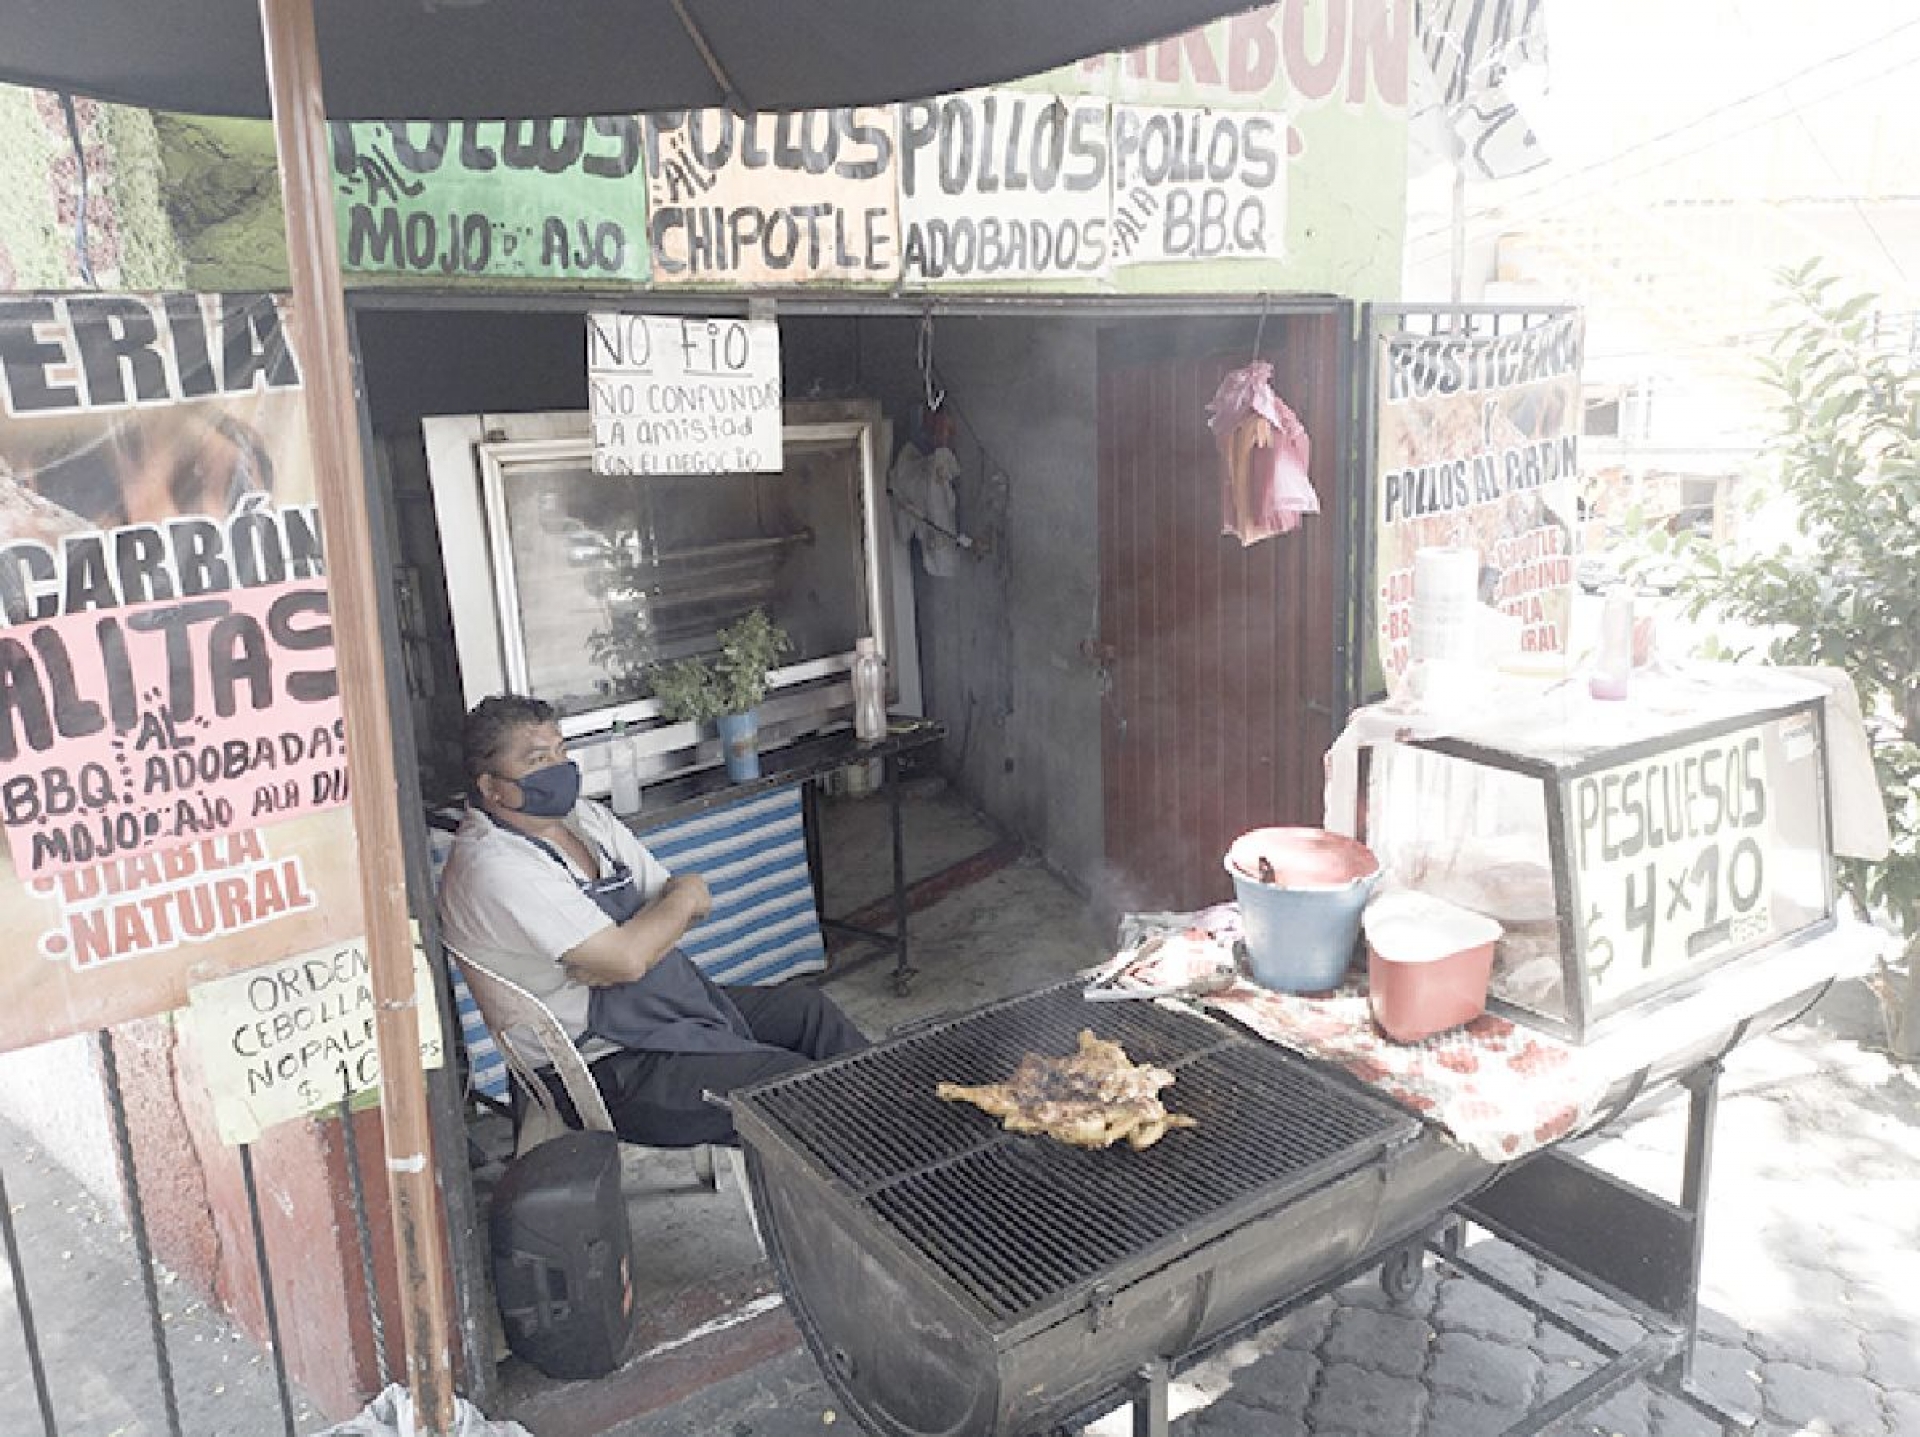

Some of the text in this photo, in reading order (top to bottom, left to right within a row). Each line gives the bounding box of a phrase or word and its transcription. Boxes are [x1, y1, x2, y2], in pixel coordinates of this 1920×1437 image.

[902, 95, 1107, 197] POLLOS
[1115, 109, 1278, 190] POLLOS
[347, 203, 491, 274] MOJO
[541, 214, 625, 271] AJO
[652, 202, 890, 275] CHIPOTLE
[904, 216, 1107, 278] ADOBADOS
[0, 293, 302, 414] ERIA
[589, 313, 651, 366] NO
[591, 383, 635, 415] NO
[0, 589, 340, 762] ALITAS
[135, 704, 195, 751] AL
[32, 811, 140, 871] MOJO
[173, 791, 234, 837] AJO
[1578, 736, 1767, 872] PESCUESOS
[67, 860, 312, 967] NATURAL
[248, 948, 369, 1013] ORDEN
